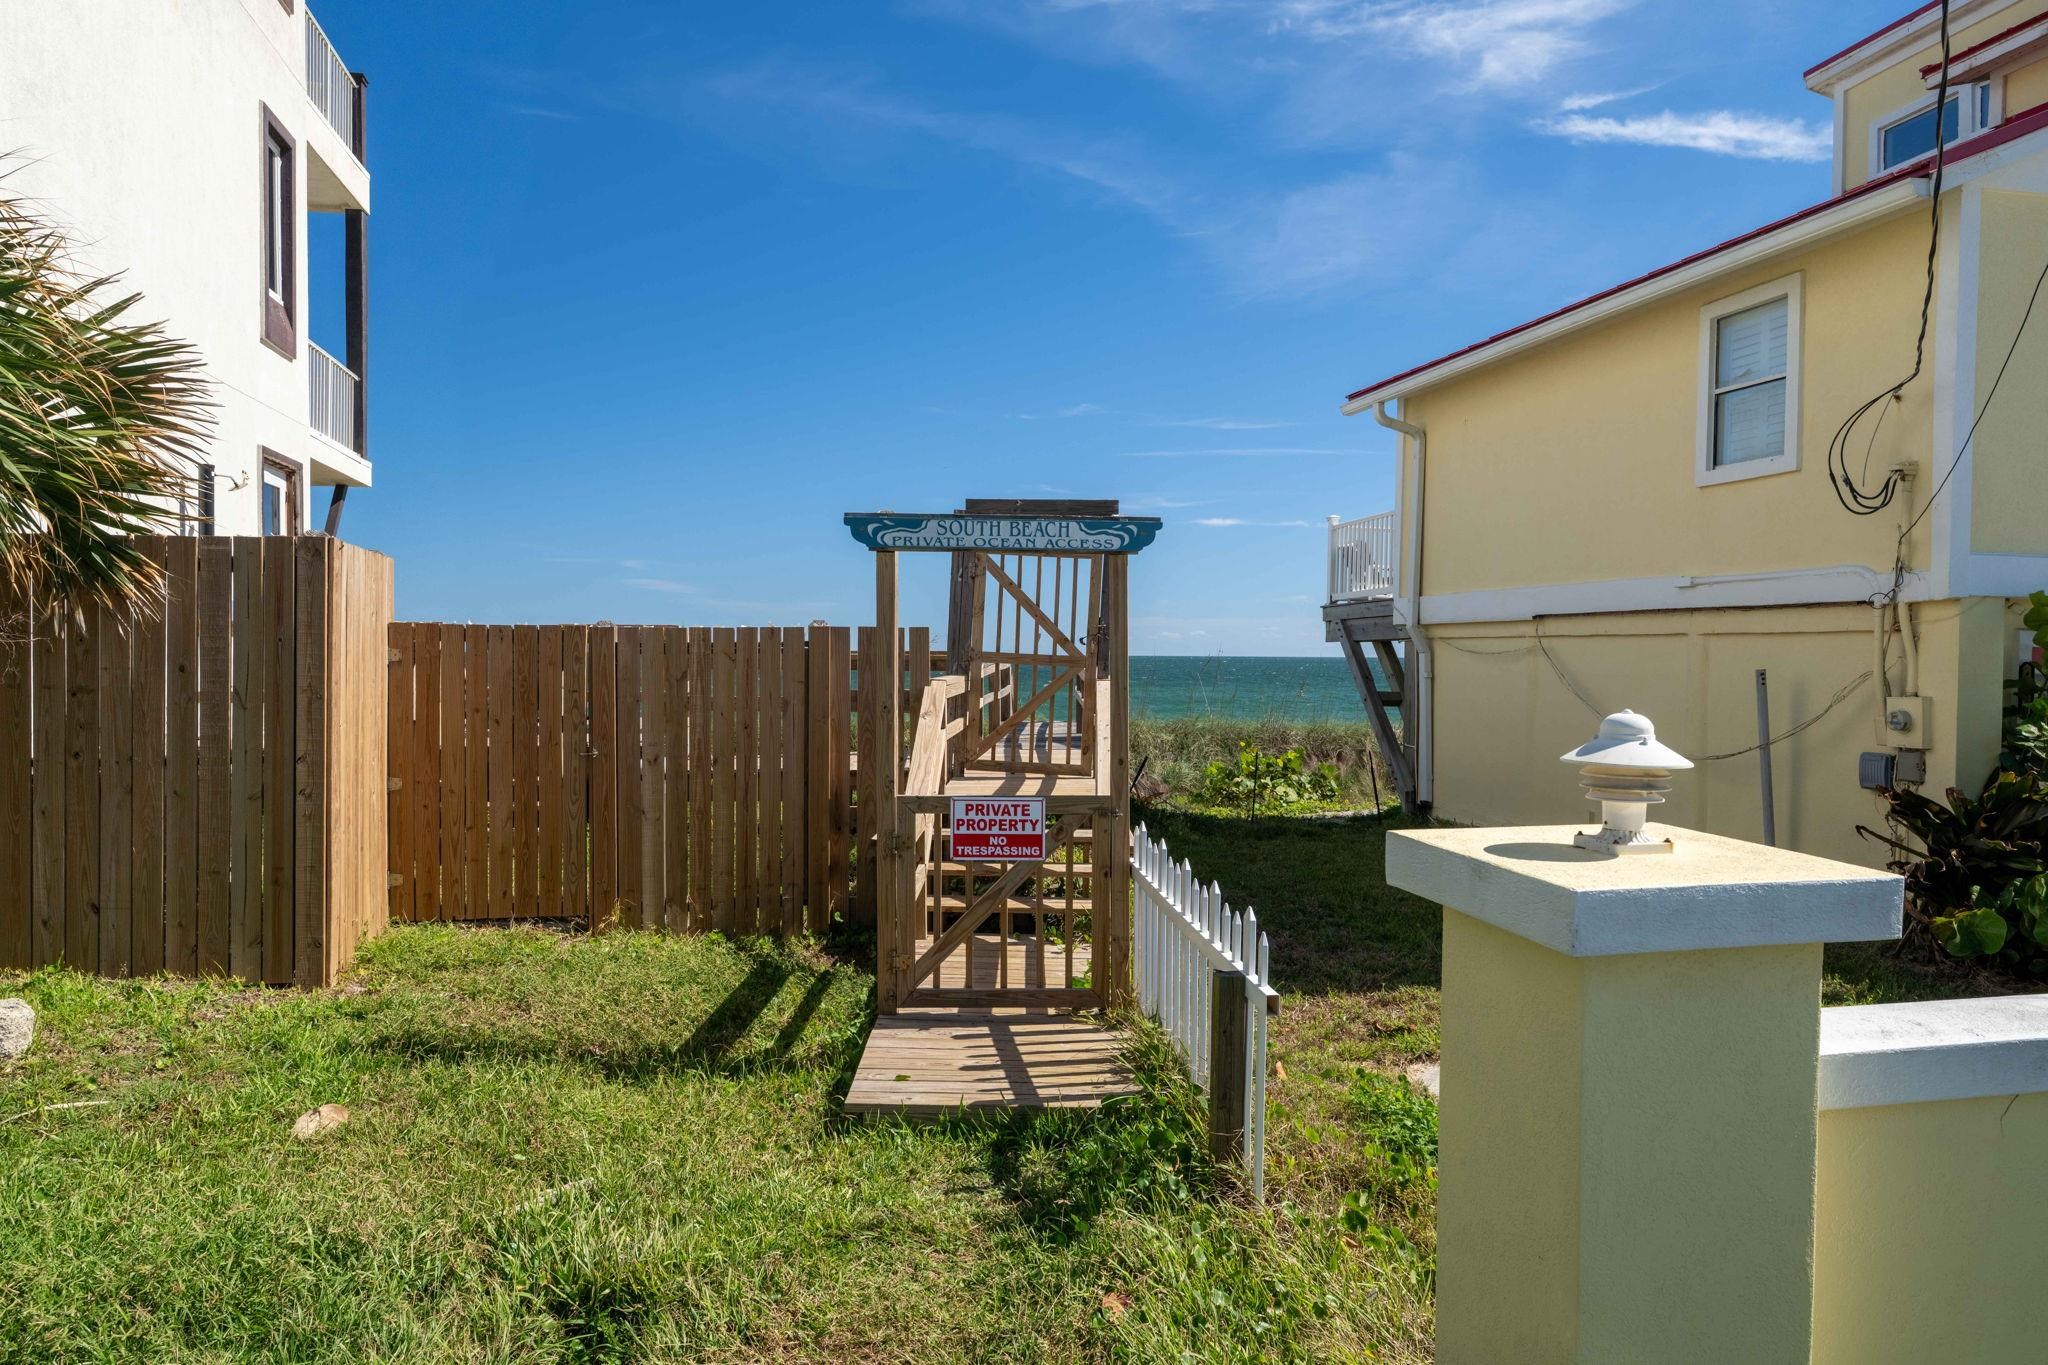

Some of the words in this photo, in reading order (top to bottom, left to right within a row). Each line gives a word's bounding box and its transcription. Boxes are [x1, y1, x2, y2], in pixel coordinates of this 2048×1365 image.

[936, 520, 1001, 537] SOUTH
[1009, 521, 1071, 538] BEACH
[892, 536, 967, 547] PRIVATE
[973, 537, 1036, 548] OCEAN
[1046, 538, 1115, 549] ACCESS
[965, 803, 1031, 817] PRIVATE
[956, 819, 1039, 831] PROPERTY
[989, 836, 1007, 845] NO
[956, 846, 1040, 856] TRESPASSING
